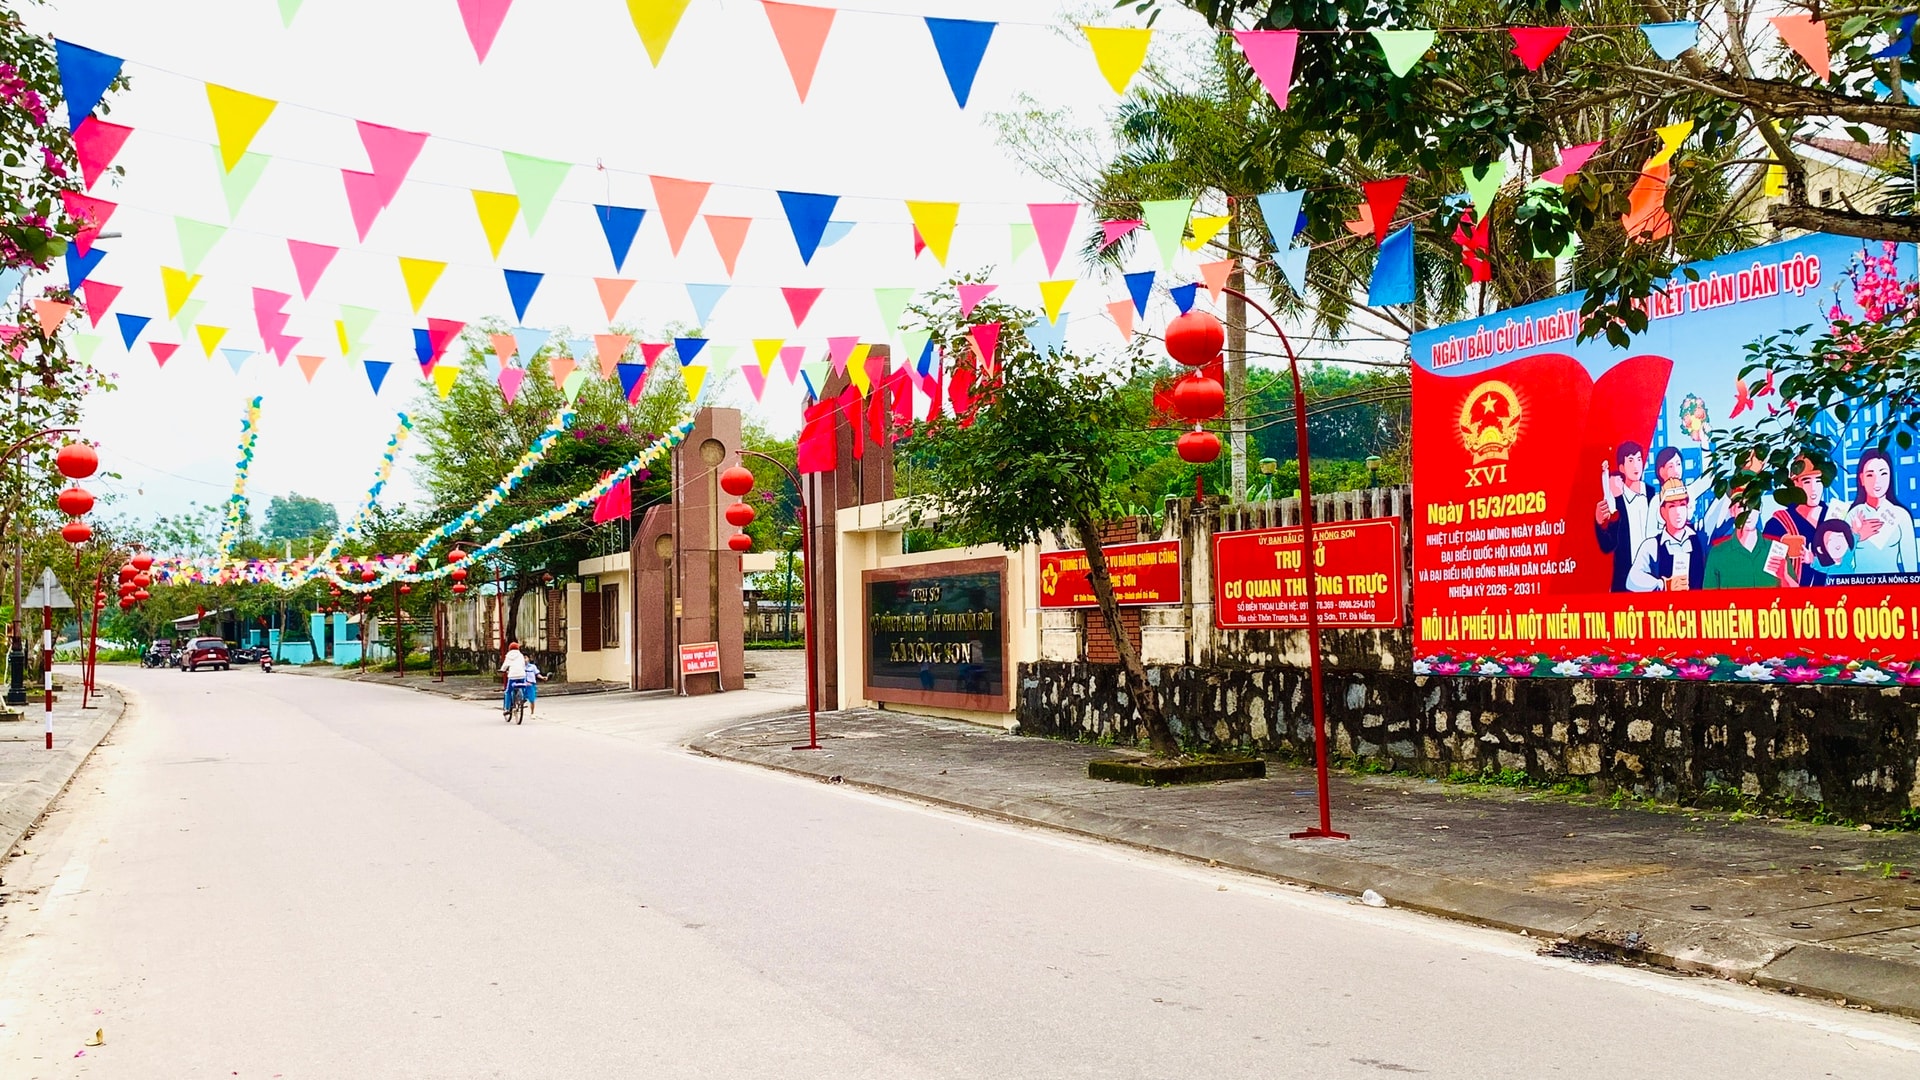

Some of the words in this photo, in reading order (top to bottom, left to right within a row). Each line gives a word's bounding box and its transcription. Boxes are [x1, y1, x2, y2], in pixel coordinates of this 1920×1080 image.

[1432, 336, 1465, 368] NGÀY
[1467, 326, 1494, 360] BẦU
[1496, 318, 1517, 352] CỬ
[1517, 317, 1535, 349] LÀ
[1537, 309, 1576, 344] NGÀY
[1655, 280, 1685, 317] KẾT
[1688, 272, 1735, 311] TOÀN
[1738, 262, 1777, 300] DÂN
[1781, 253, 1819, 296] TỘC
[1465, 464, 1507, 487] XVI
[1427, 501, 1464, 525] Ngày
[1468, 491, 1546, 520] 15/3/2026
[1426, 531, 1447, 547] NHIỆT
[1449, 530, 1464, 546] LIỆT
[1466, 528, 1486, 542] CHÀO
[1487, 526, 1510, 540] MỪNG
[1511, 524, 1533, 538] NGÀY
[1553, 519, 1566, 535] CỬ
[1275, 550, 1301, 572] TRỤ
[1312, 542, 1326, 567] Ở
[1441, 550, 1454, 564] ĐẠI
[1455, 545, 1472, 562] BIỂU
[1473, 545, 1493, 561] QUỐC
[1494, 545, 1508, 560] HỘI
[1509, 543, 1532, 557] KHÓA
[1534, 543, 1548, 556] XVI
[1419, 568, 1429, 582] VÀ
[1430, 569, 1442, 583] ĐẠI
[1443, 563, 1460, 581] BIỂU
[1461, 565, 1474, 580] HỘI
[1498, 562, 1520, 577] NHÂN
[1521, 561, 1539, 575] DÂN
[1540, 560, 1557, 575] CÁC
[1559, 557, 1577, 574] CẤP
[1888, 575, 1909, 583] NÔNG
[1225, 580, 1242, 599] CƠ
[1246, 579, 1281, 599] QUAN
[1347, 572, 1388, 598] TRỰC
[1449, 584, 1473, 600] NHIỆM
[1474, 583, 1485, 596] KỲ
[1486, 584, 1507, 596] 2026
[1514, 583, 1536, 595] 2031
[1421, 607, 1443, 641] MỖI
[1445, 610, 1459, 640] LÁ
[1461, 606, 1496, 640] PHIẾU
[1498, 608, 1514, 640] LÀ
[1516, 608, 1543, 645] MỘT
[1583, 611, 1611, 642] TIN,
[1613, 604, 1645, 645] MỘT
[1648, 603, 1697, 639] TRÁCH
[1701, 602, 1754, 645] NHIỆM
[1758, 597, 1787, 639] ĐỐI
[1790, 600, 1821, 639] VỚI
[1824, 594, 1848, 639] TỔ
[1852, 595, 1905, 643] QUỐC
[1911, 606, 1919, 640] !
